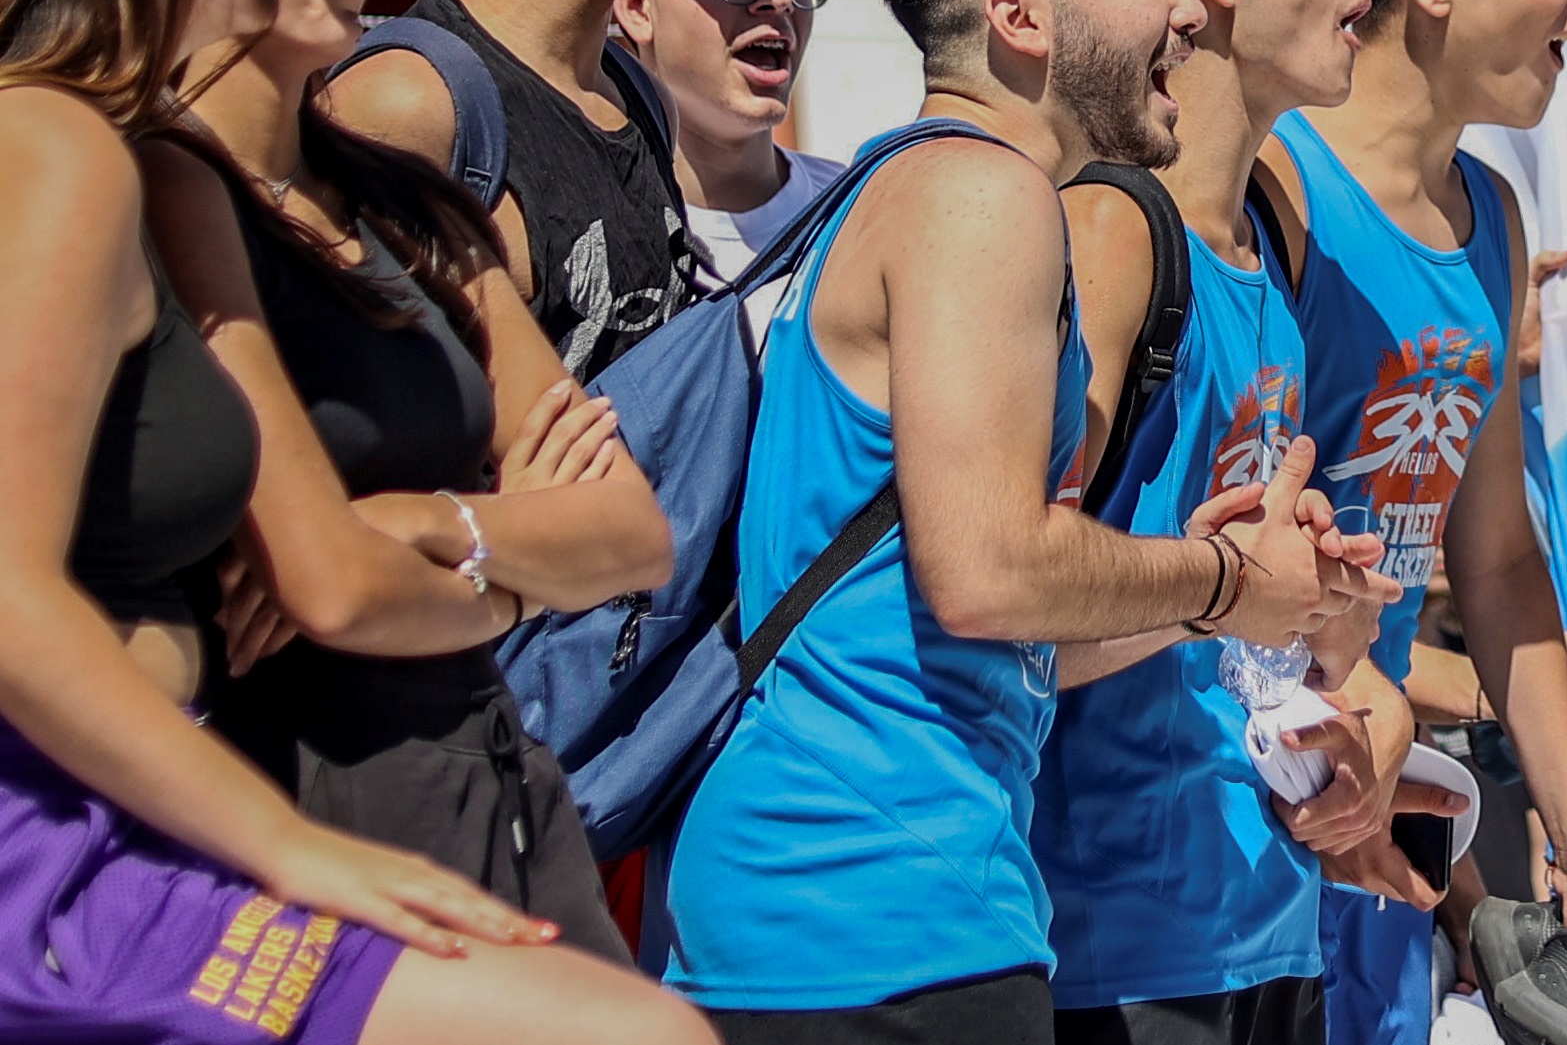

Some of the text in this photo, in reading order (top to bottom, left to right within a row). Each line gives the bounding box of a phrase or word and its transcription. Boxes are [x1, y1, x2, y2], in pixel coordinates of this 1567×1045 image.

[1376, 502, 1443, 544] STREET
[189, 956, 240, 1005] LOS
[224, 926, 298, 1021] LAKERS
